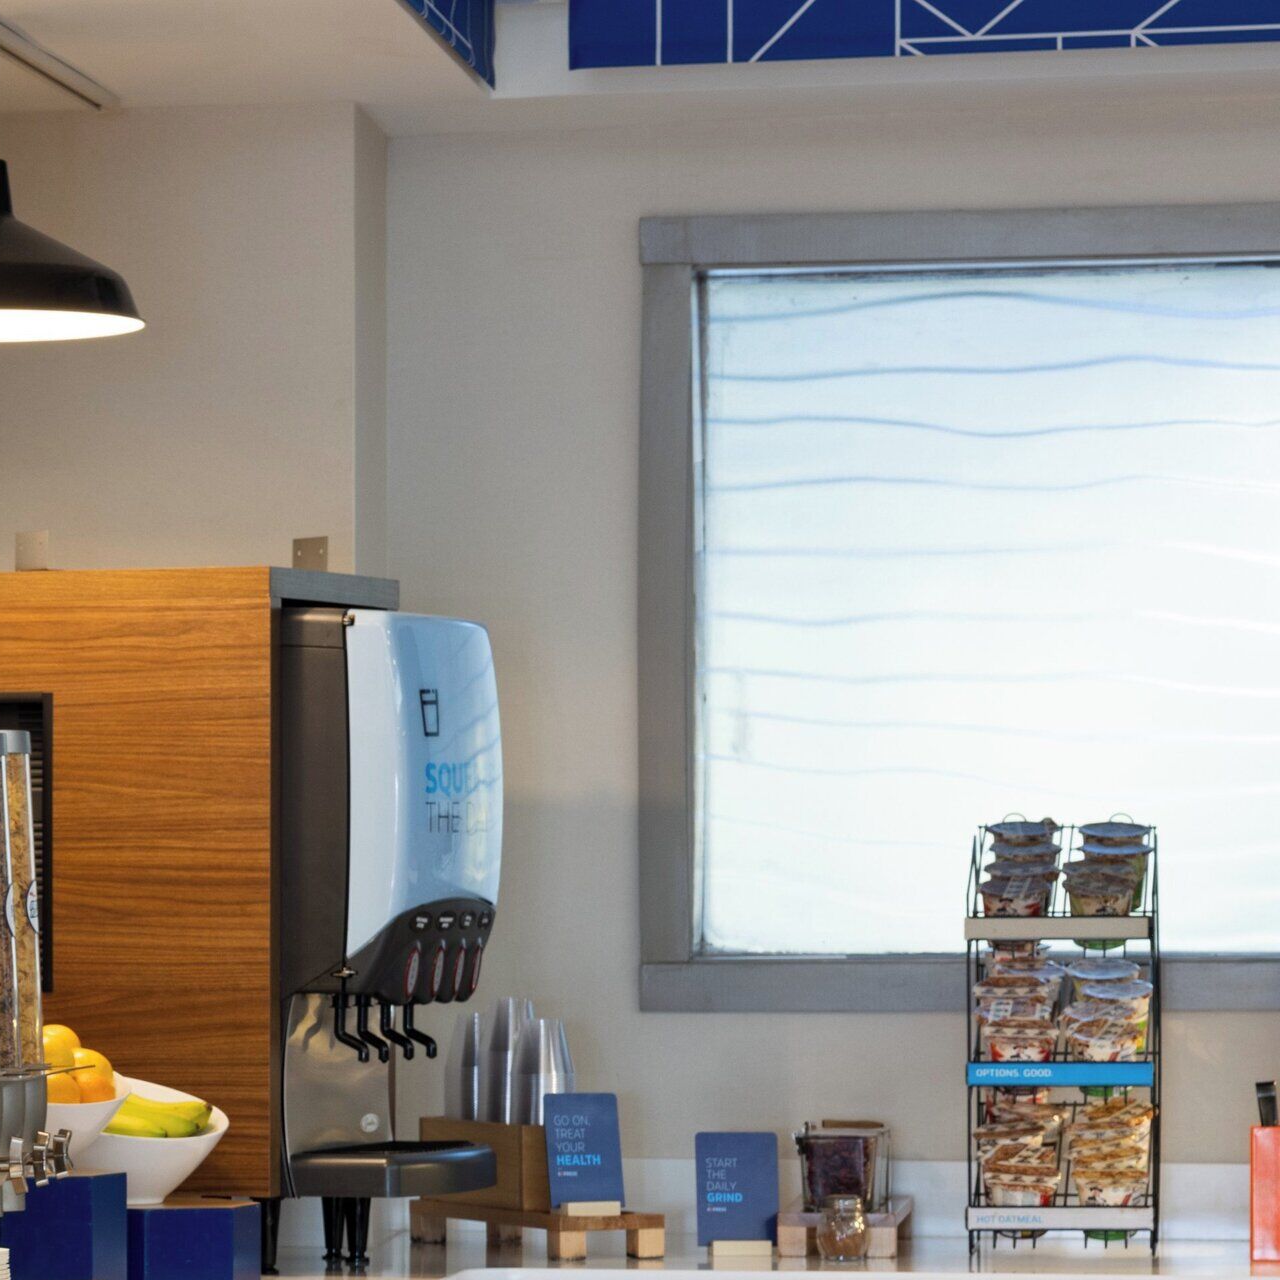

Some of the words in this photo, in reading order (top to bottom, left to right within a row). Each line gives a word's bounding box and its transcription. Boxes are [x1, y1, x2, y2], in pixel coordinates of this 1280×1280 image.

[424, 801, 462, 834] THE
[553, 1114, 570, 1126] GO
[555, 1127, 586, 1139] TREAT
[556, 1141, 585, 1153] YOUR
[556, 1154, 602, 1166] HEALTH
[705, 1157, 738, 1169] START
[706, 1169, 727, 1180] THE
[706, 1181, 737, 1192] DAILY
[706, 1192, 744, 1204] GRIND
[976, 1215, 995, 1224] HOT
[998, 1215, 1043, 1224] OATMEAL
